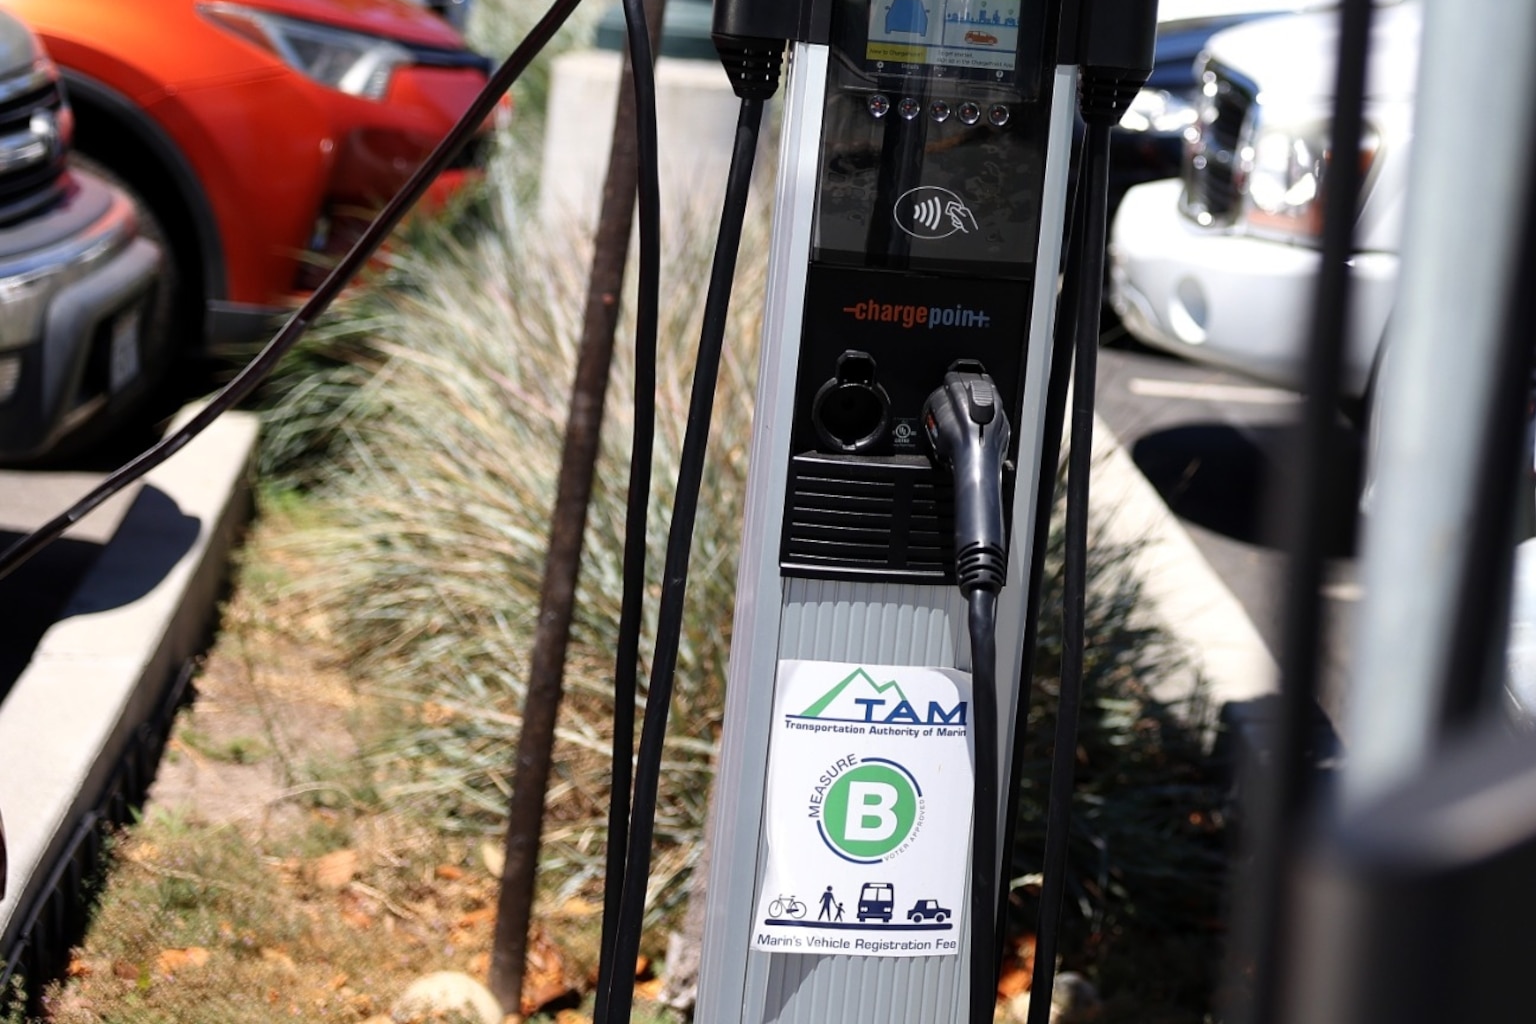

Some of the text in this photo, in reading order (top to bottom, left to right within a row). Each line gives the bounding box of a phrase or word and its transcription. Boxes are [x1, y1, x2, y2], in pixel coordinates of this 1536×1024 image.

[785, 719, 967, 738] Transportation Authority of Marin
[854, 698, 968, 724] TAM
[808, 753, 858, 818] MEASURE
[844, 780, 899, 841] B
[884, 799, 926, 862] VOTER APPROVED
[757, 933, 957, 953] Marin's Vehicle Registration Fee
